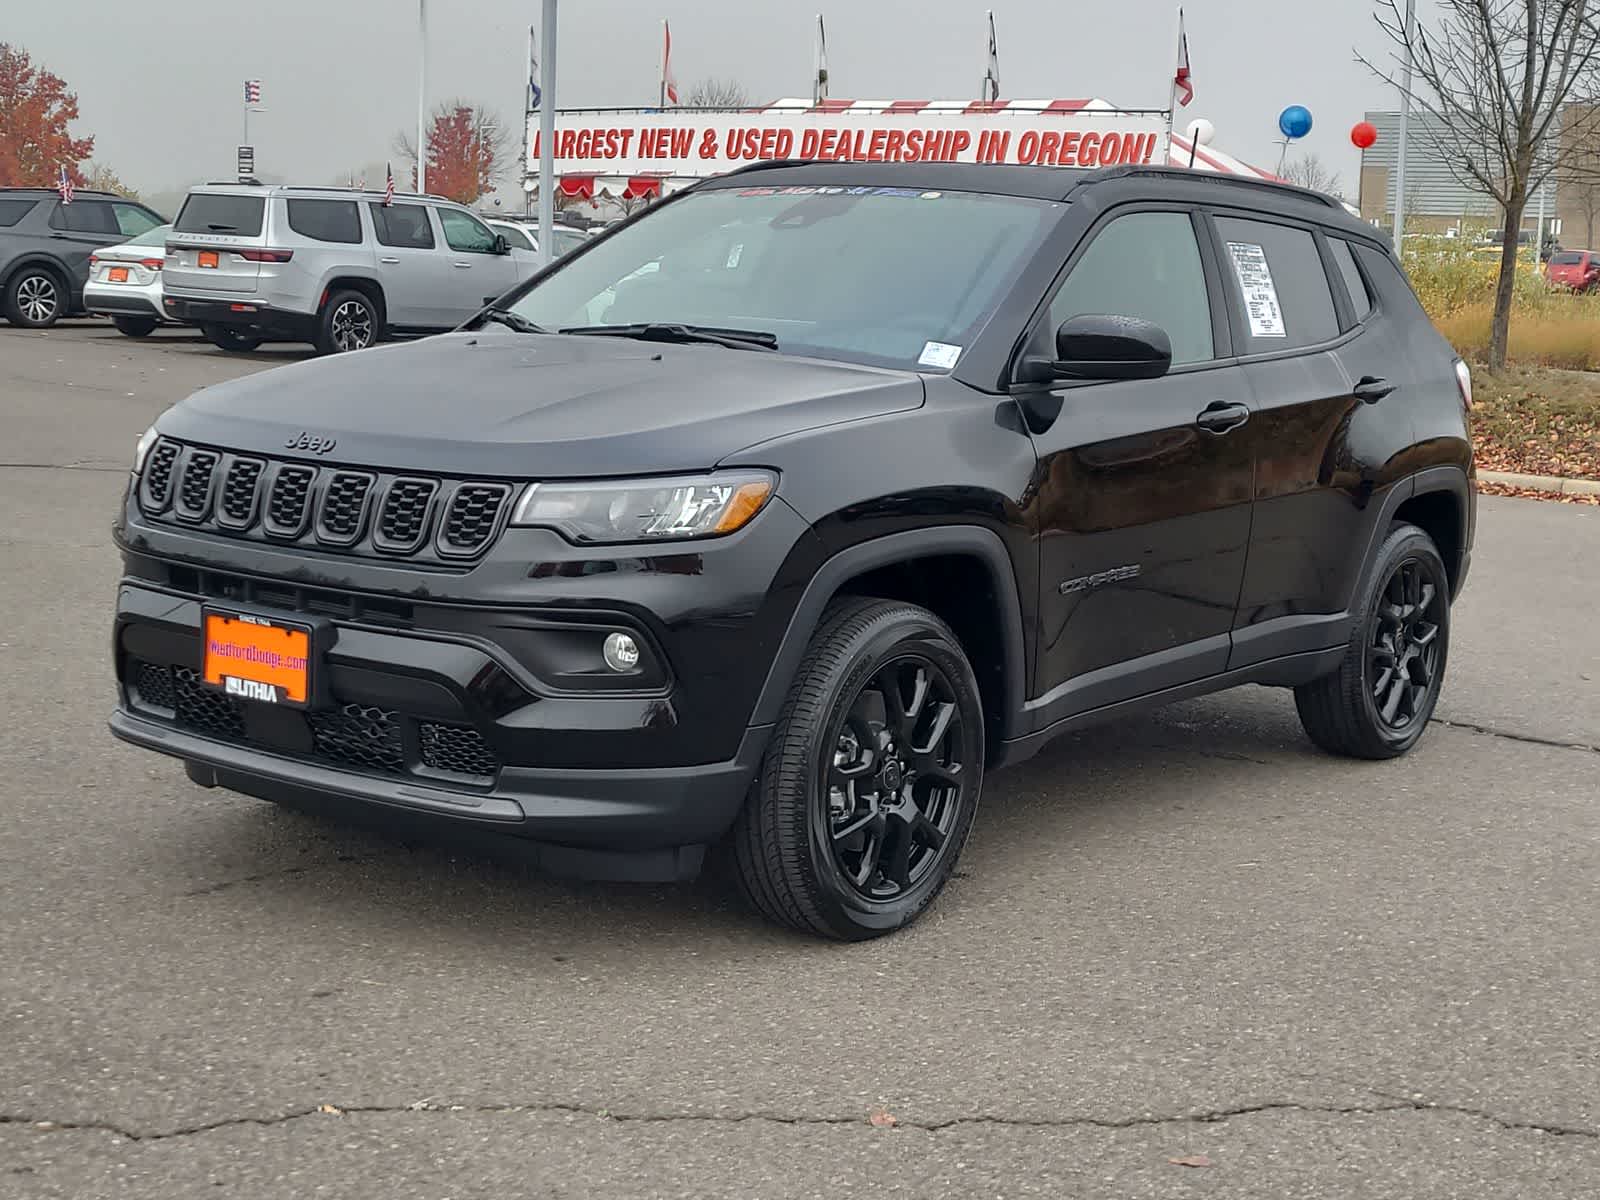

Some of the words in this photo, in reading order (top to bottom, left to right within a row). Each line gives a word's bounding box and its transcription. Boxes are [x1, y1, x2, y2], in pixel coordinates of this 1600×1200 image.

[639, 128, 695, 160] NEW
[699, 128, 719, 160] &
[725, 128, 794, 161] USED
[800, 129, 971, 163] DEALERSHIP
[976, 130, 1012, 164] IN
[1017, 130, 1157, 167] OREGON!
[284, 431, 337, 455] Jeep
